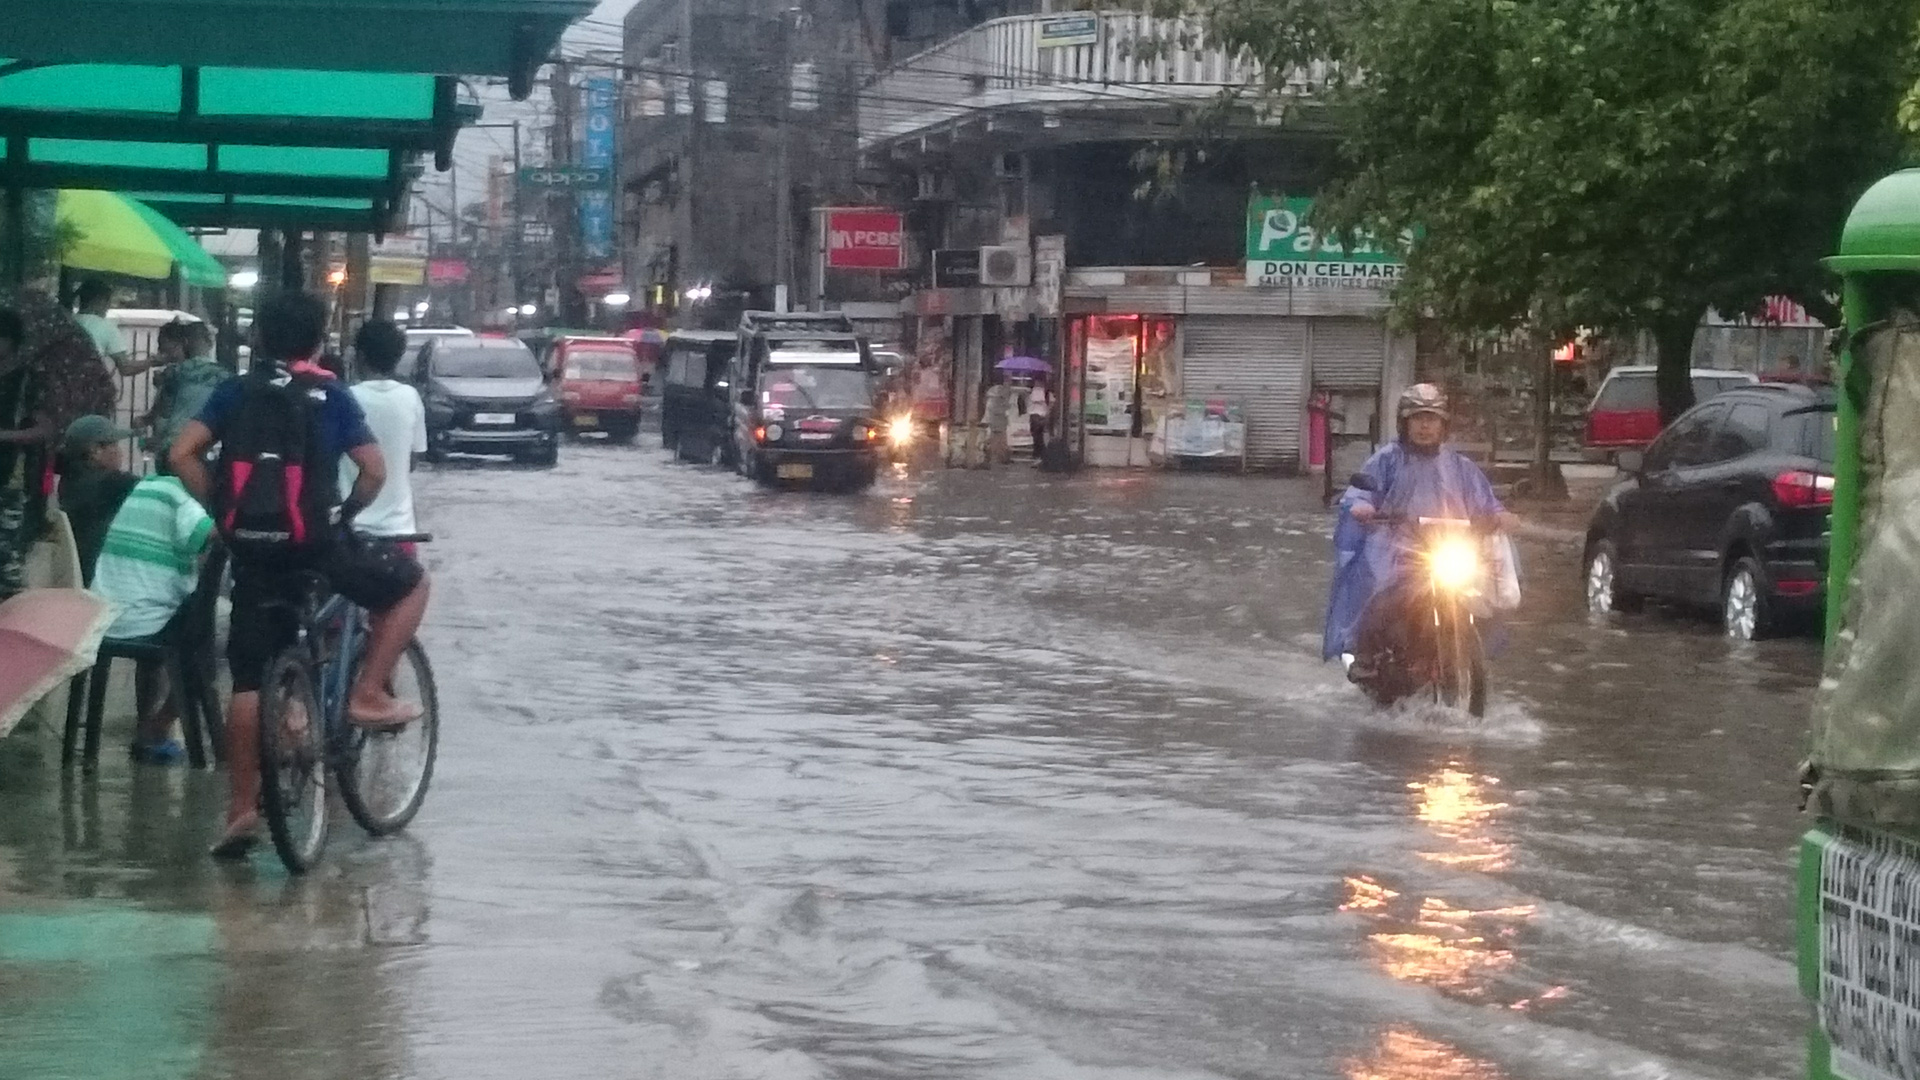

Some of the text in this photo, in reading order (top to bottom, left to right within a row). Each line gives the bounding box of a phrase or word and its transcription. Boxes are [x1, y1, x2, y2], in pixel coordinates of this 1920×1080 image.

[531, 172, 600, 185] oppo
[855, 230, 903, 246] PCBS
[1265, 262, 1406, 278] DON CELMART
[1259, 276, 1293, 287] SALES
[1297, 277, 1304, 287] &
[1308, 277, 1362, 288] SERVICES
